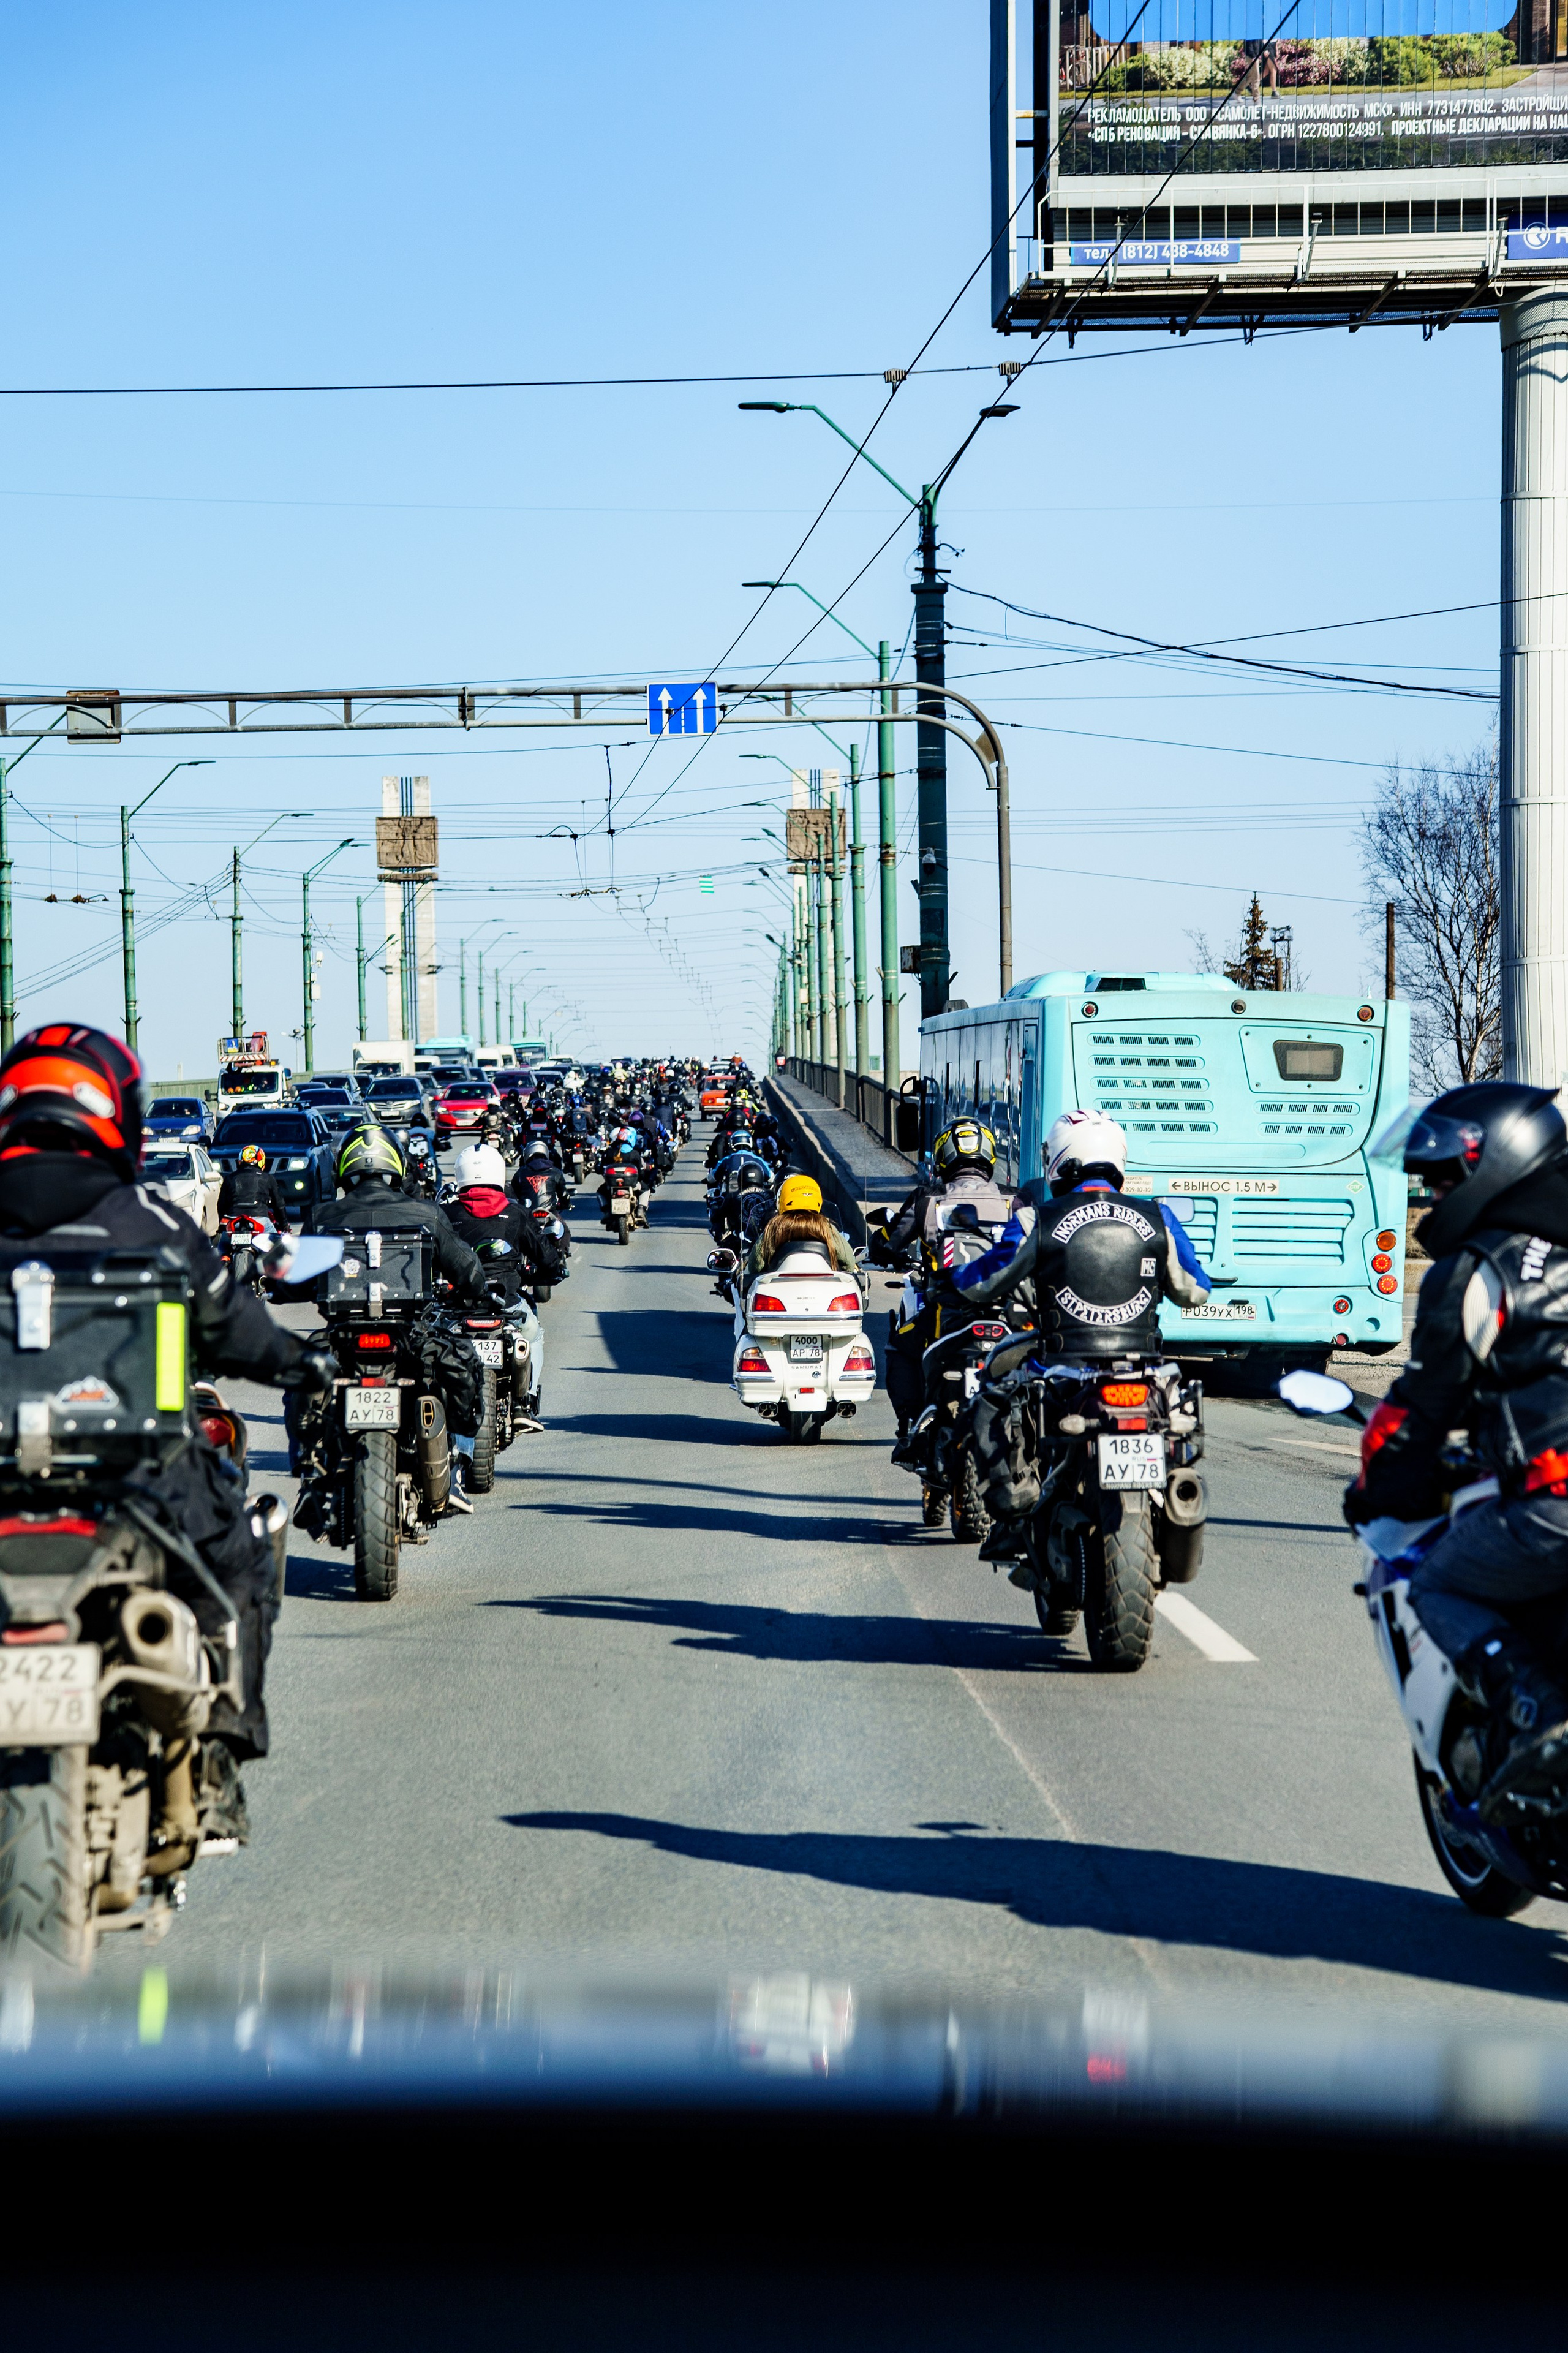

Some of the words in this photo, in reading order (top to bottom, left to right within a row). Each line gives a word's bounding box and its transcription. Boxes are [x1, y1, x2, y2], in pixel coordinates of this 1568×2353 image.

[1087, 106, 1182, 123] РЕКЛАМОДАТЕЛЬ
[1186, 105, 1207, 121] ООО
[1364, 101, 1395, 118] МСК».
[1400, 100, 1422, 117] ИНН
[1427, 98, 1497, 116] 7731477602.
[1502, 93, 1568, 113] ЗАСТРОЙЩИ
[1087, 125, 1115, 142] «СПБ
[1117, 125, 1181, 142] РЕНОВАЦИЯ
[1268, 123, 1295, 139] ОГРН
[1298, 120, 1384, 139] 1227800124991.
[1392, 118, 1457, 135] ПРОЕКТНЫЕ
[1458, 115, 1531, 135] ДЕКЛАРАЦИИ
[1532, 114, 1548, 130] НА
[1122, 245, 1158, 260] (812)
[1183, 1181, 1231, 1192] ВЫНОС
[1236, 1182, 1251, 1192] 1.5
[1255, 1182, 1266, 1192] М
[1056, 1203, 1110, 1239] NORMANS
[1113, 1206, 1152, 1236] RIDERS
[1521, 1236, 1553, 1281] THE
[1144, 1260, 1155, 1275] MC
[1061, 1292, 1149, 1324] ST.PETERSBURG
[1235, 1305, 1253, 1315] 198
[795, 1337, 818, 1345] 4000
[486, 1354, 500, 1364] 42
[355, 1392, 391, 1404] 1822
[377, 1410, 394, 1421] 78
[1109, 1438, 1153, 1455] 1836
[1137, 1464, 1159, 1479] 78
[44, 1698, 84, 1726] 78
